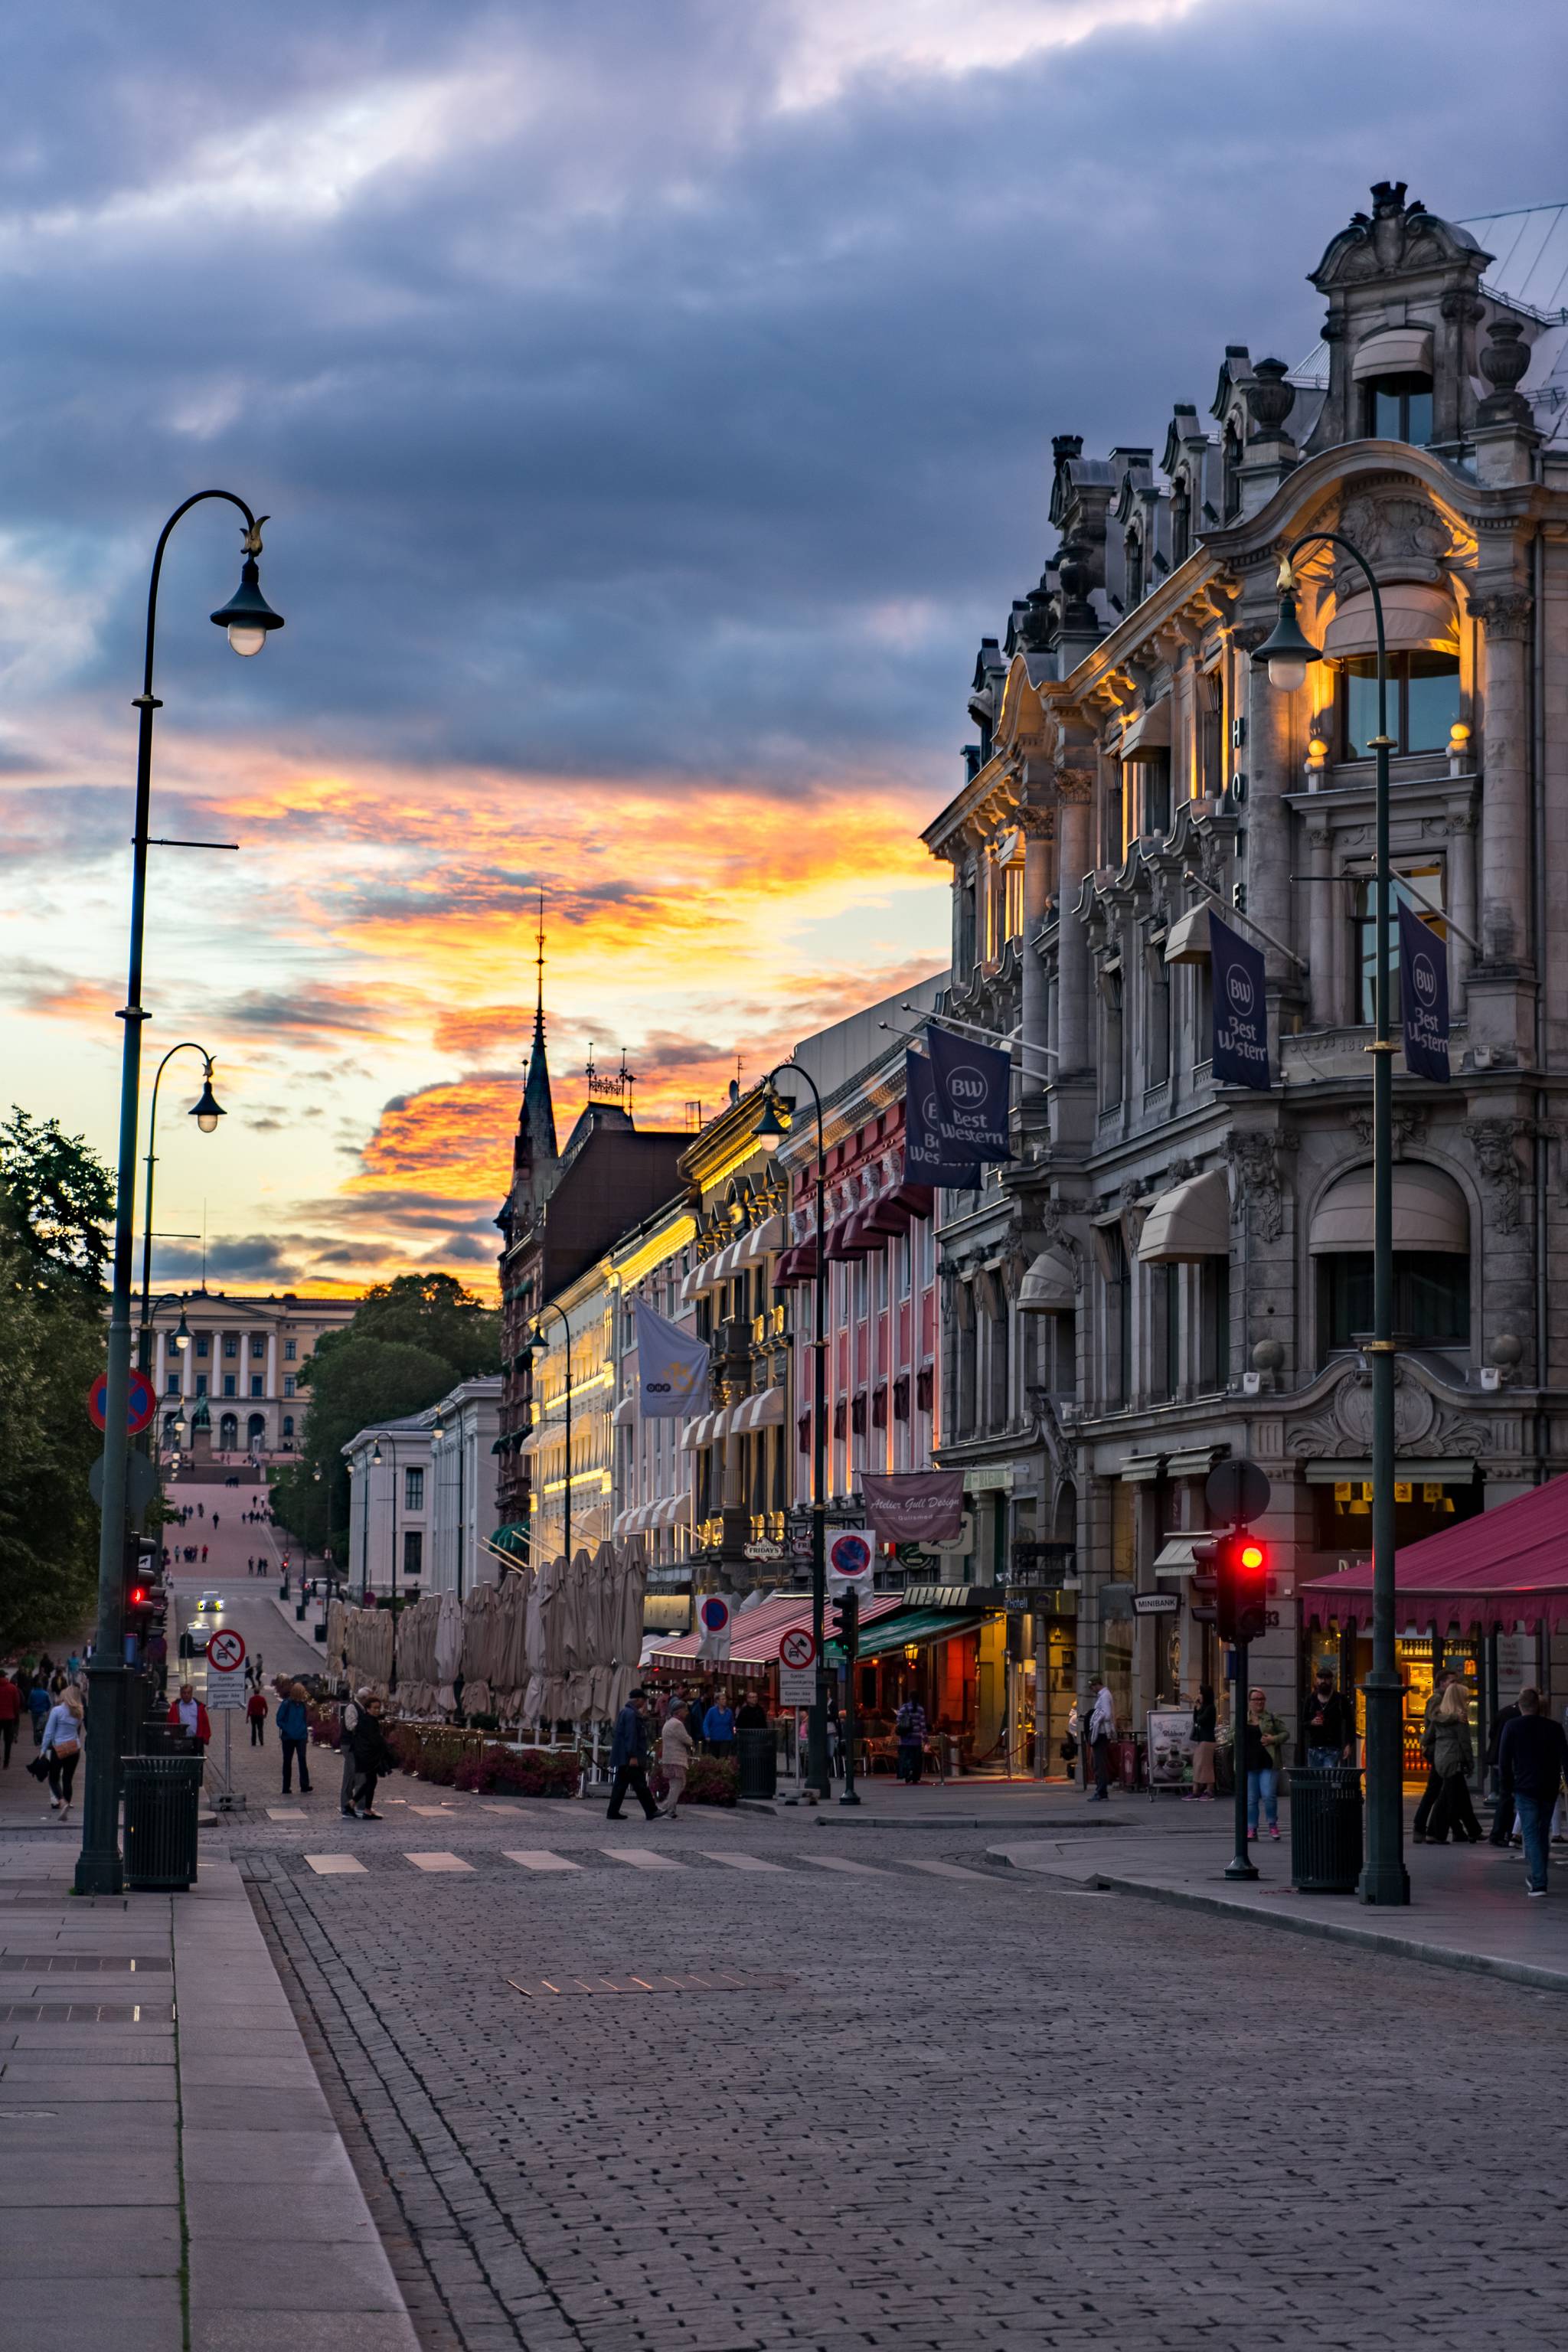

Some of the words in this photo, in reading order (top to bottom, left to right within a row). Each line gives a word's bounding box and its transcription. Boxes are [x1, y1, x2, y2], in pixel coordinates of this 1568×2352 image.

[1231, 979, 1251, 1003] BW
[1416, 969, 1434, 993] BW
[1228, 1016, 1257, 1041] Best
[1415, 1007, 1439, 1032] Best
[1407, 1021, 1449, 1053] Wstern
[952, 1080, 984, 1098] BW
[952, 1109, 988, 1129] Best
[940, 1123, 1004, 1145] Western
[870, 1498, 901, 1510] Atelier
[904, 1498, 926, 1512] Gull
[927, 1497, 959, 1510] Design
